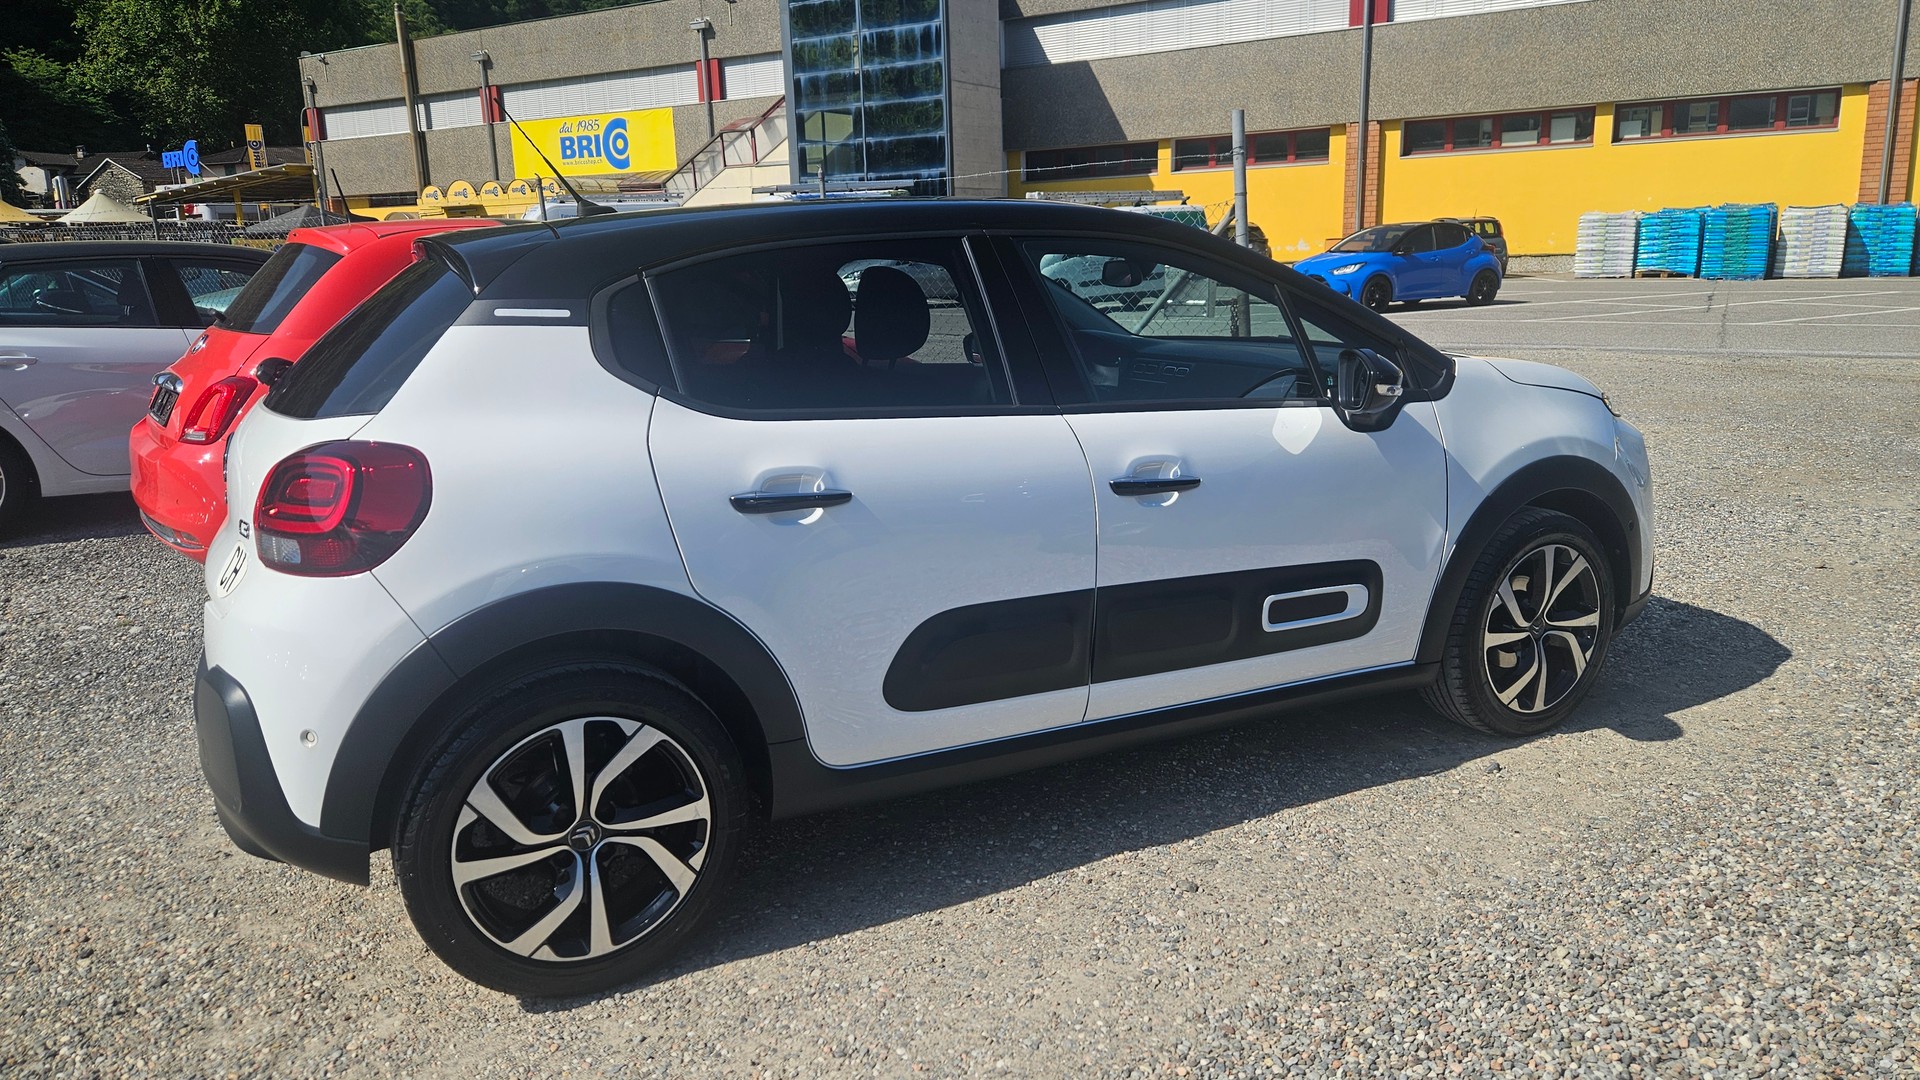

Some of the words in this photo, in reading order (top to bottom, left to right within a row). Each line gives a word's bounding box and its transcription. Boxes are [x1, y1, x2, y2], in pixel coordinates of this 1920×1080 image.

[559, 121, 573, 133] dal
[576, 119, 600, 133] 1985
[560, 117, 631, 170] BRICO
[162, 139, 200, 175] BRICO
[219, 545, 247, 593] CH
